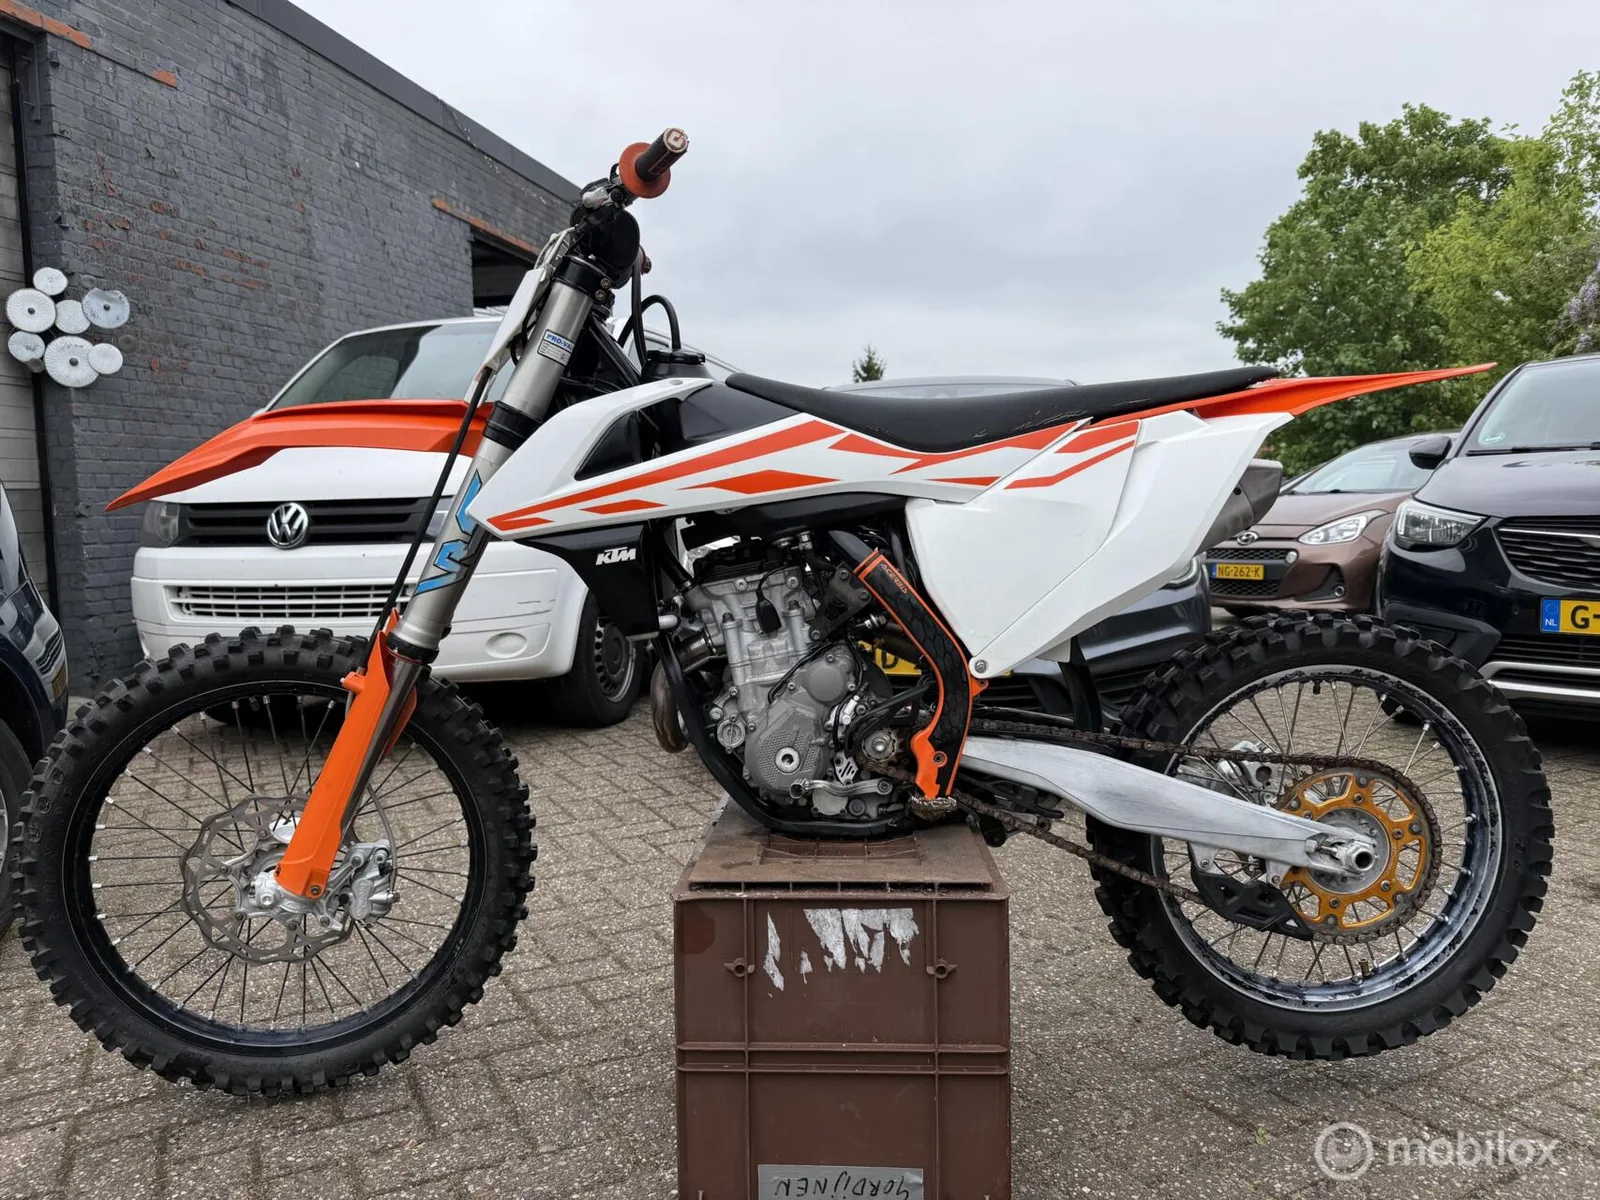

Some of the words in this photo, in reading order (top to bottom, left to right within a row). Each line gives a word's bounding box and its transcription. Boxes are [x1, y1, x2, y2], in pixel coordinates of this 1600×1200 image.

[595, 546, 637, 566] KTM
[1218, 565, 1261, 578] NG-262-K
[1545, 618, 1558, 627] NL
